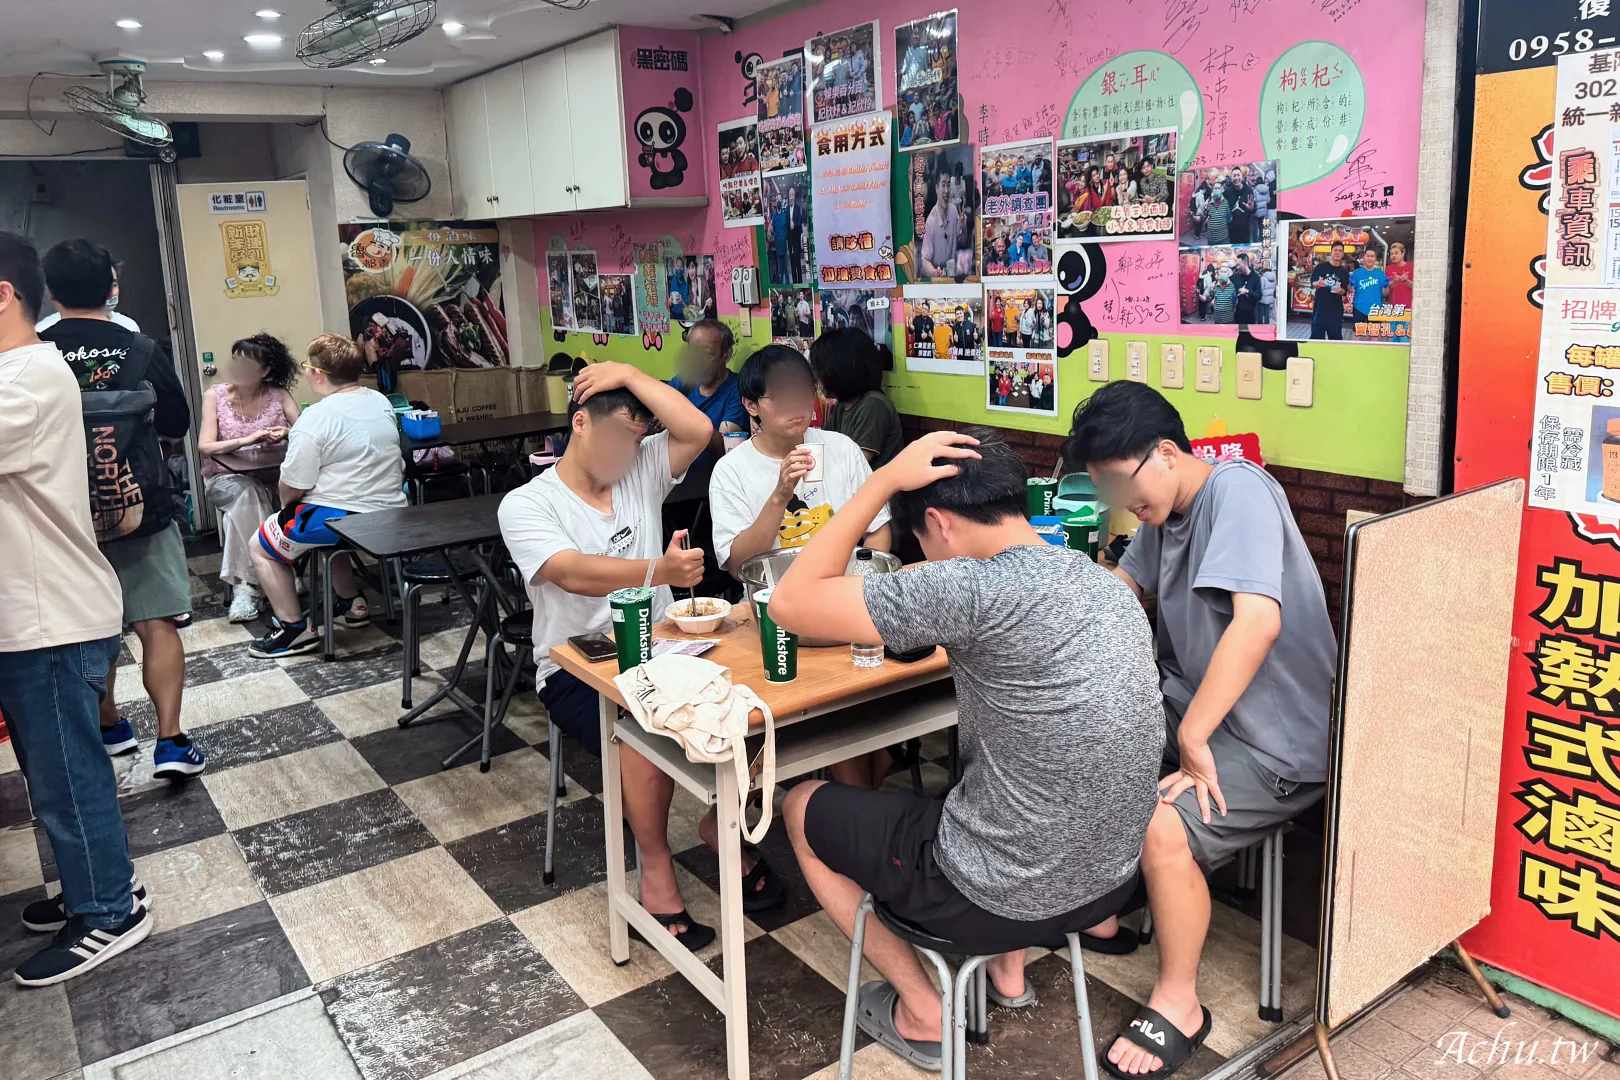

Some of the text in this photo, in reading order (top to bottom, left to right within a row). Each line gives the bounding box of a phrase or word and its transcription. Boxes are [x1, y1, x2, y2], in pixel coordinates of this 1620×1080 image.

[637, 45, 688, 71] 黑密碼
[816, 130, 886, 156] 食用方式
[212, 194, 245, 205] 化粧室
[987, 194, 1048, 215] 老外調查團
[1561, 152, 1597, 268] 乘車資訊
[830, 232, 874, 252] 請珍惜
[409, 245, 494, 267] 一份人情味
[821, 264, 894, 284] 勿浪費食物
[1359, 277, 1379, 290] Sprite
[472, 403, 497, 412] COFFEE
[1534, 414, 1561, 501] 保存期限1年
[1559, 427, 1584, 471] 需冷藏
[92, 426, 125, 510] NORTH
[118, 458, 144, 507] THE
[1520, 560, 1620, 938] 加熱式滷味
[1130, 1018, 1166, 1046] FILA
